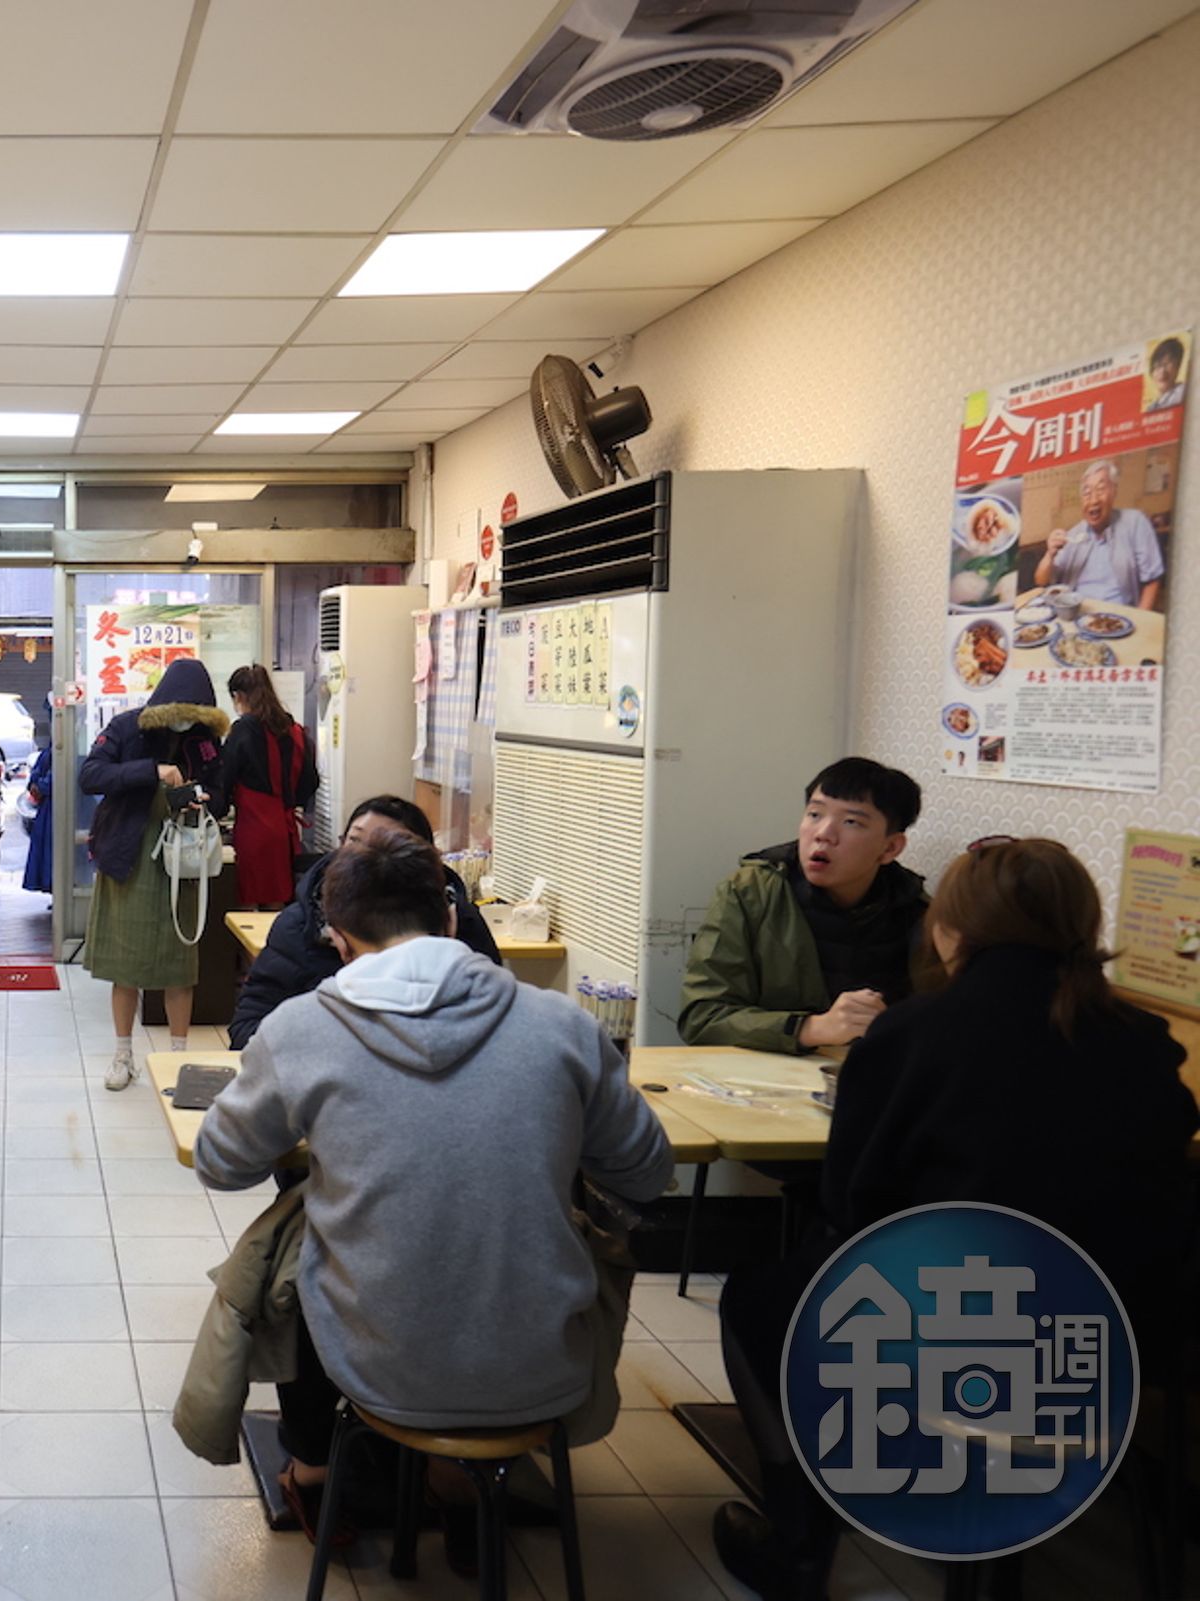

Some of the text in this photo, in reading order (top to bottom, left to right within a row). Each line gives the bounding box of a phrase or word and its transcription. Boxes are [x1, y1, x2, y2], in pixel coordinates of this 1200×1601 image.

[967, 397, 1104, 474] 今周刊
[94, 611, 131, 694] 冬至
[134, 626, 194, 644] 12月21日
